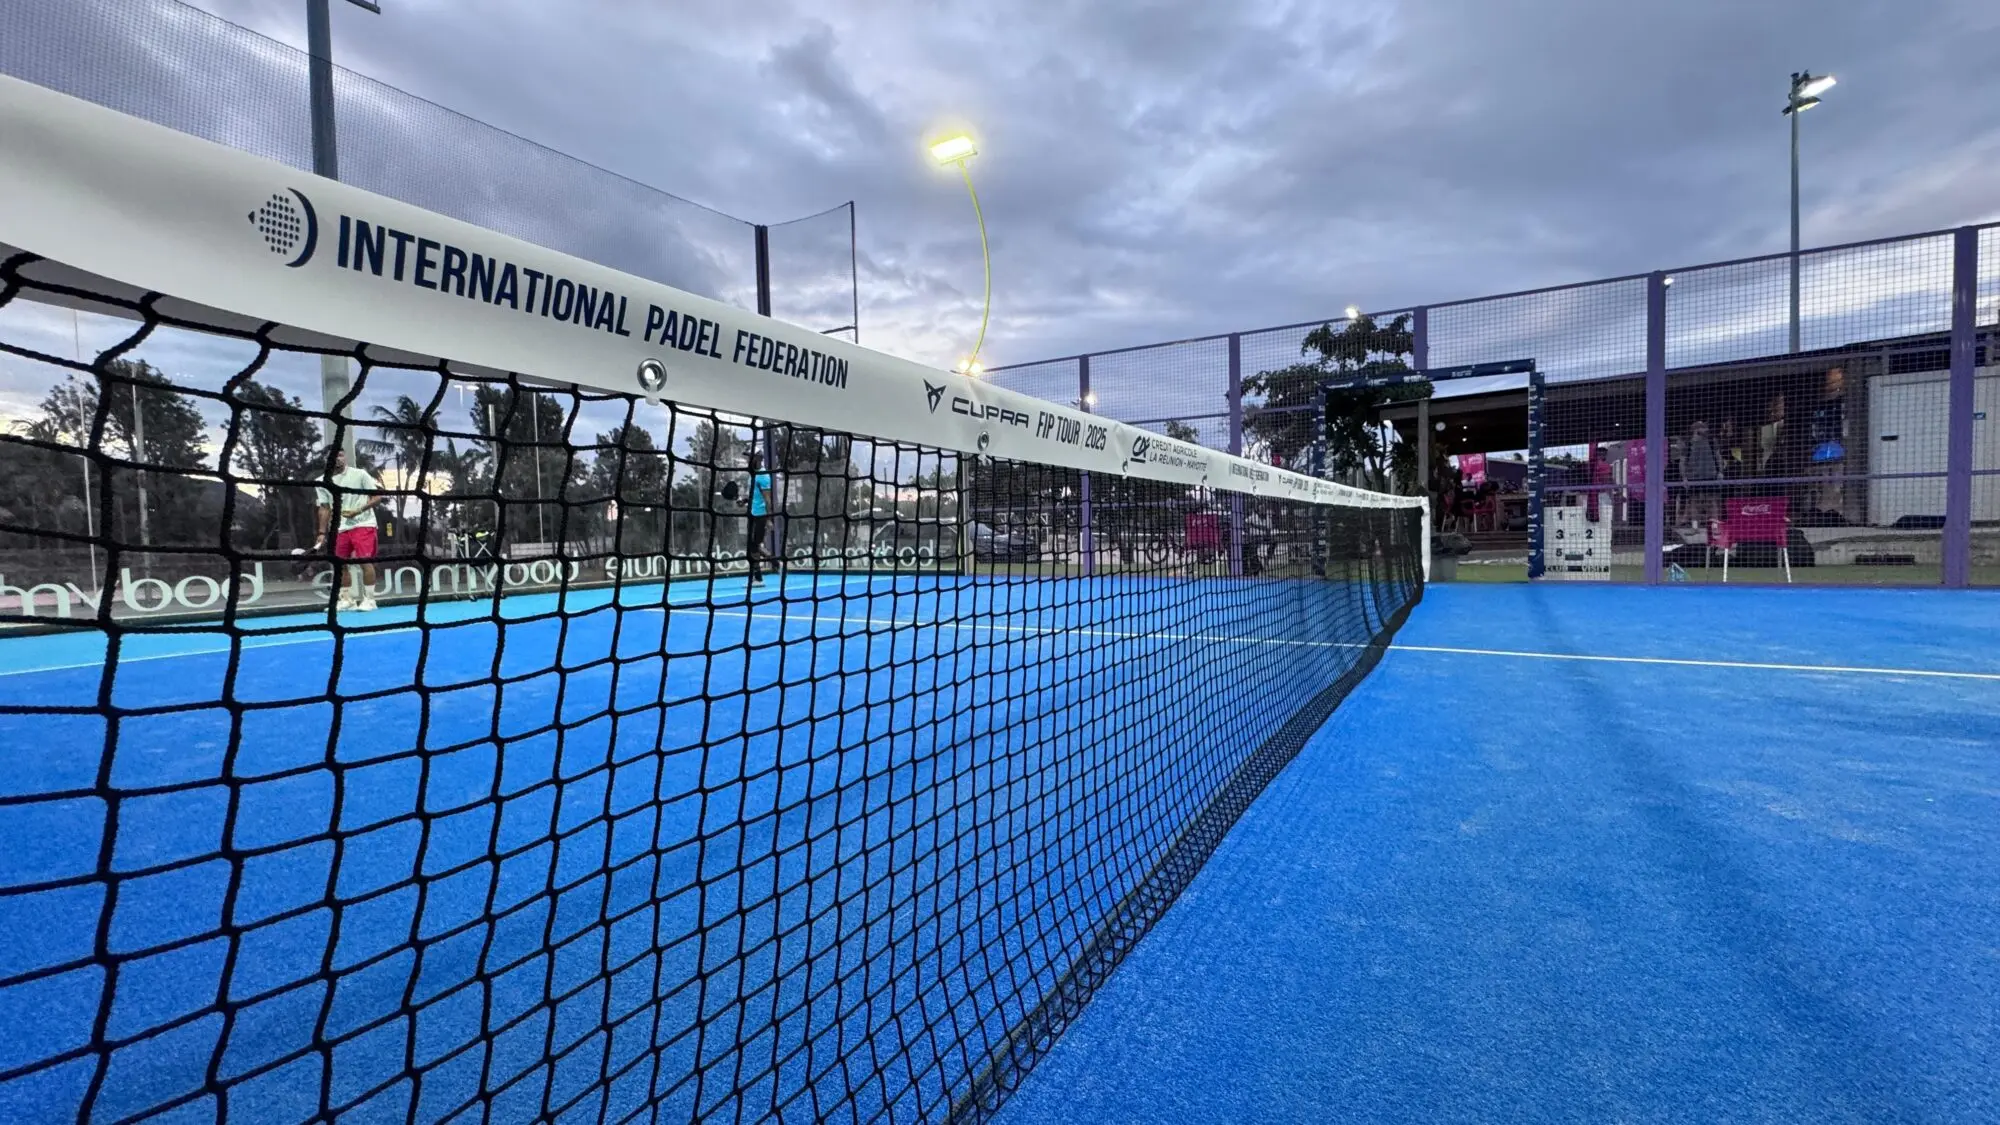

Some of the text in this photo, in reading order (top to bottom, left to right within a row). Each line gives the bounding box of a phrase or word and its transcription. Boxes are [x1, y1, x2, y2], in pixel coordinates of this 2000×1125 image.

[337, 215, 849, 390] INTERNATIONAL PADEL FEDERATION
[951, 396, 1107, 451] CUPRA FIP TOUR 2025
[1173, 444, 1198, 458] AGRICOLE
[1556, 529, 1564, 539] 3
[1586, 529, 1593, 539] 2
[1586, 548, 1592, 556] 4
